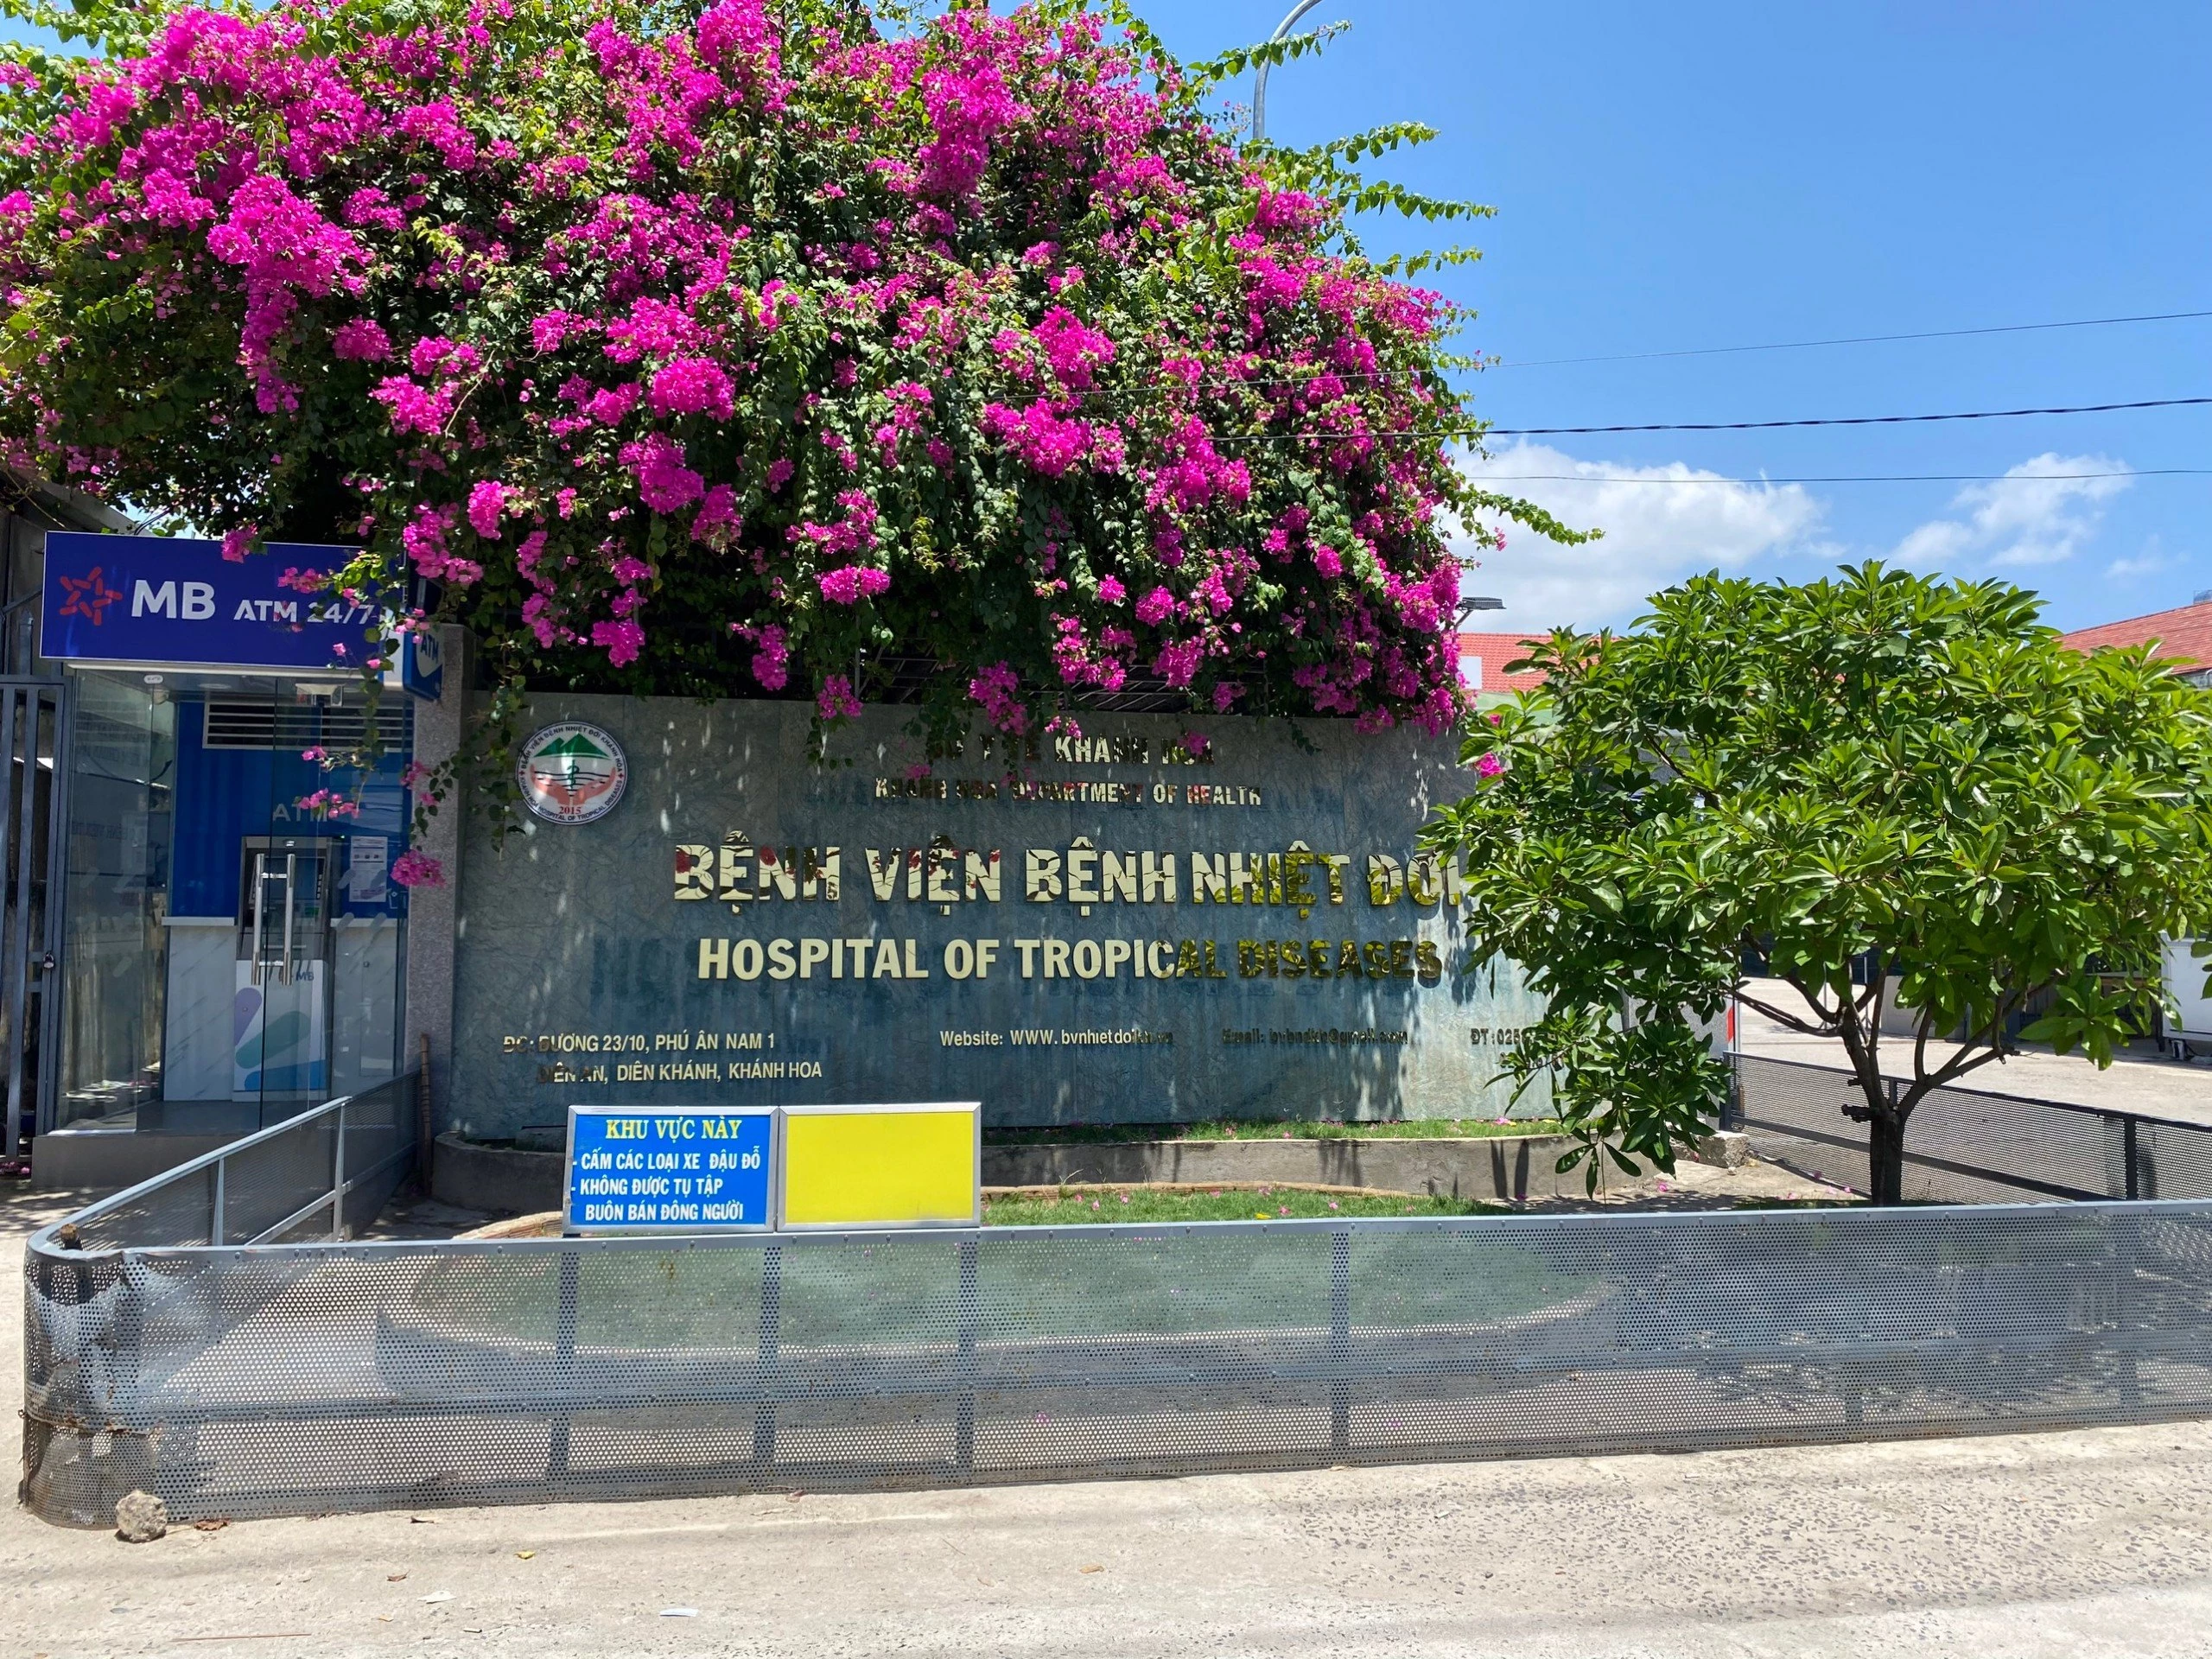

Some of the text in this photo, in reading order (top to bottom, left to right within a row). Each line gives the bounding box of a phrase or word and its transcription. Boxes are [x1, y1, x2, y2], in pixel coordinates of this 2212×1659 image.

[131, 580, 216, 620] MB
[233, 600, 375, 625] ATM 24/7
[420, 633, 439, 663] ATM
[1153, 784, 1179, 804] OF
[1186, 785, 1262, 805] HEALTH
[272, 803, 327, 822] ATM
[674, 830, 841, 915] BỆNH
[864, 835, 1001, 916] VIỆN
[1026, 836, 1176, 918] BỆNH
[1192, 840, 1351, 919] NHIỆT
[697, 938, 1443, 981] HOSPITAL OF TROPICAL DISEASES
[602, 1034, 650, 1053] 23/10,
[655, 1030, 689, 1050] PHÚ
[696, 1031, 718, 1050] ÂN
[726, 1033, 761, 1049] NAM
[768, 1033, 775, 1048] 1
[940, 1030, 1003, 1046] Website:
[617, 1061, 654, 1080] DIÊN
[659, 1060, 721, 1083] KHÁNH,
[729, 1060, 785, 1078] KHÁNH
[606, 1116, 742, 1143] KHU VỰC NÀY
[582, 1147, 612, 1169] CẤM
[616, 1149, 644, 1169] CÁC
[648, 1153, 678, 1173] LOẠI
[683, 1154, 700, 1169] XE
[709, 1149, 737, 1173] ĐẬU
[741, 1146, 760, 1169] ĐỖ
[581, 1174, 627, 1195] KHÔNG
[632, 1176, 670, 1198] ĐƯỢC
[674, 1179, 691, 1198] TỤ
[696, 1175, 723, 1198] TẬP
[586, 1199, 743, 1221] BUÔN BÁN ĐÔNG NGƯỜI
